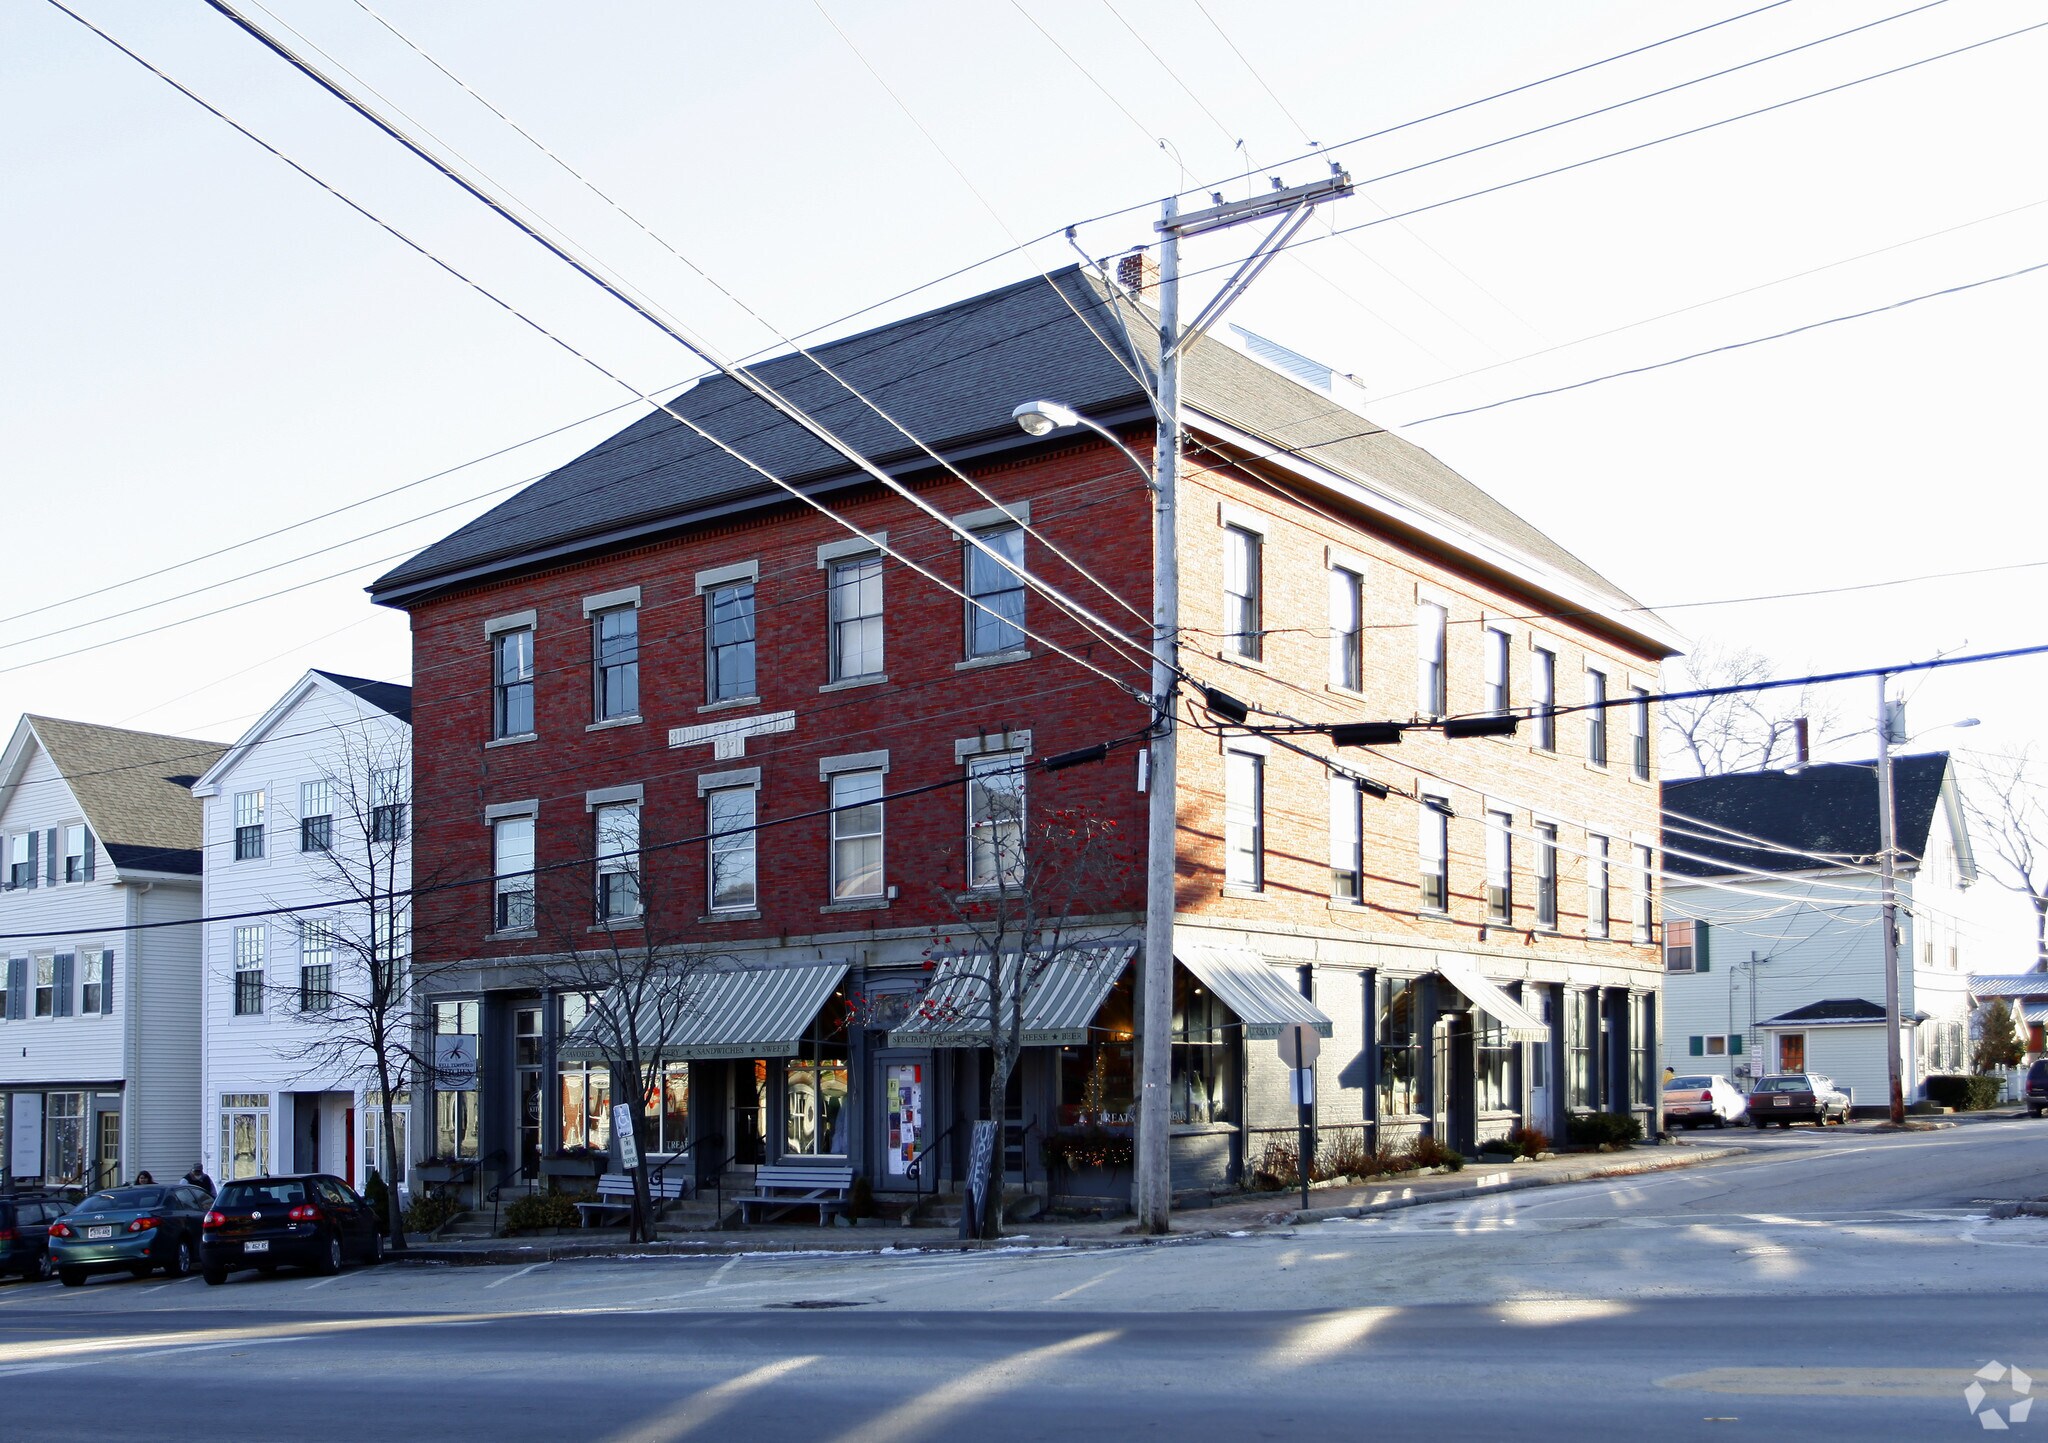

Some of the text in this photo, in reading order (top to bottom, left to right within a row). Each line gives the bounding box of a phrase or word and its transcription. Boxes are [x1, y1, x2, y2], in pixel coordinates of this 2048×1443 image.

[748, 710, 795, 735] BLOCK
[891, 1034, 933, 1044] SPECIALTY
[1061, 1032, 1082, 1040] BEER
[564, 1050, 596, 1058] SAVORIES
[696, 1046, 745, 1056] SANDWICHES
[761, 1044, 791, 1054] SWEETS
[1099, 1112, 1135, 1122] TREATS
[666, 1140, 689, 1150] TREAT
